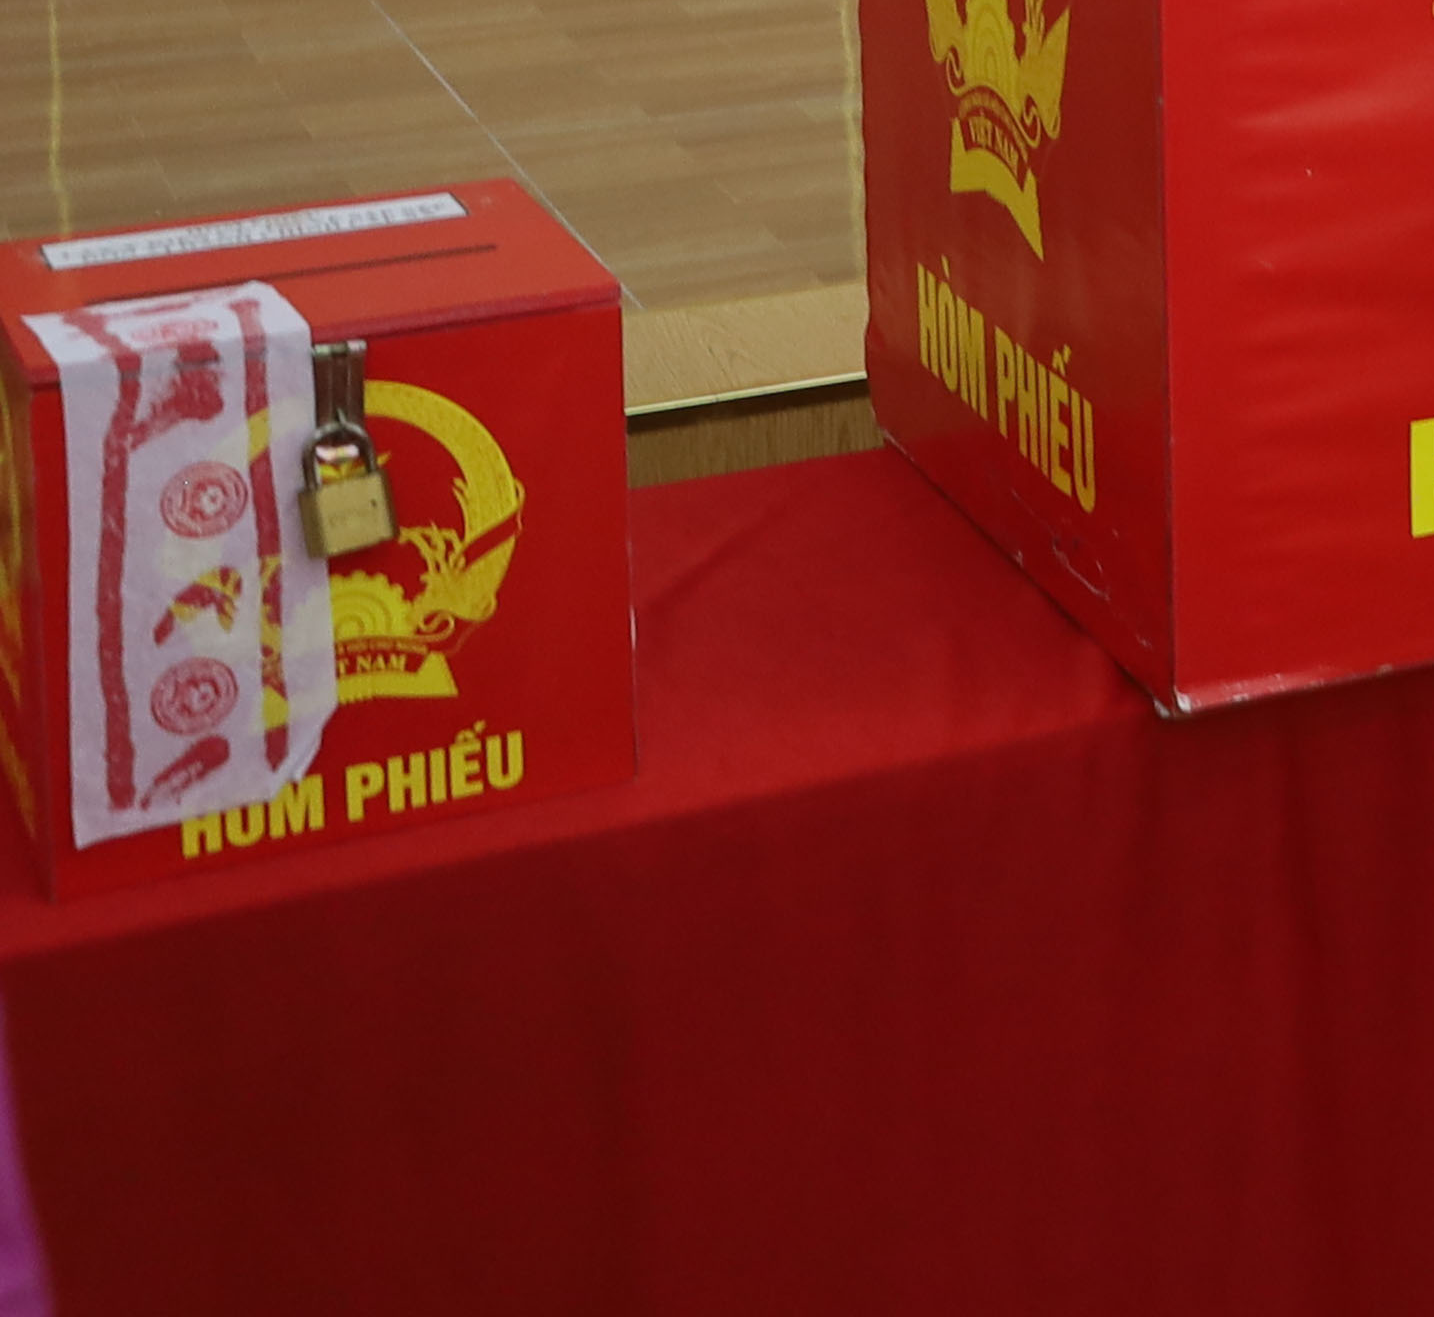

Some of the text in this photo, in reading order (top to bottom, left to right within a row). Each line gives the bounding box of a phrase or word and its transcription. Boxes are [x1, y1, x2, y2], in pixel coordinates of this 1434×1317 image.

[918, 258, 1093, 509] HÒM PHIẾU
[347, 723, 523, 820] PHIẾU
